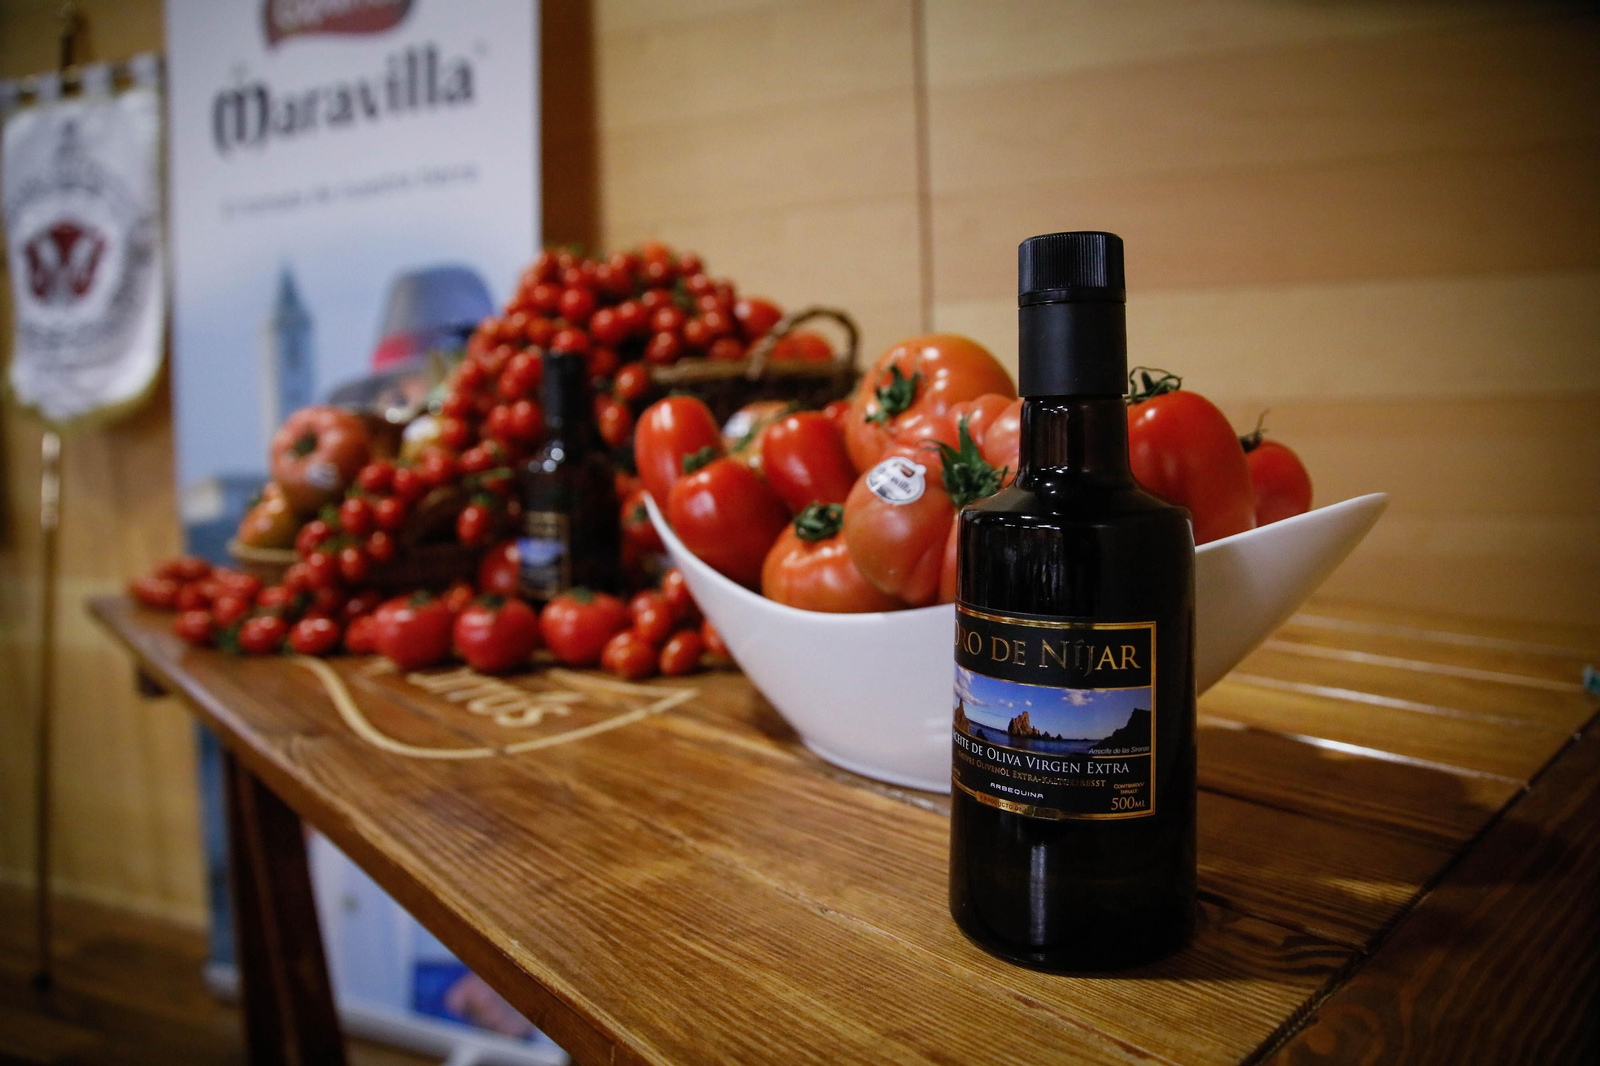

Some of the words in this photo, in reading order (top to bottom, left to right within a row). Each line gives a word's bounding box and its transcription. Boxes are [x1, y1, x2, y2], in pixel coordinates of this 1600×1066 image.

[211, 41, 476, 157] Maravilla
[991, 635, 1027, 666] DE
[1038, 638, 1142, 677] NÍJAR
[971, 742, 983, 757] DE
[986, 746, 1022, 767] OLIVA
[1025, 755, 1081, 774] VIRGEN
[1087, 761, 1130, 774] EXTRA
[989, 782, 1044, 799] ARBEQUINA
